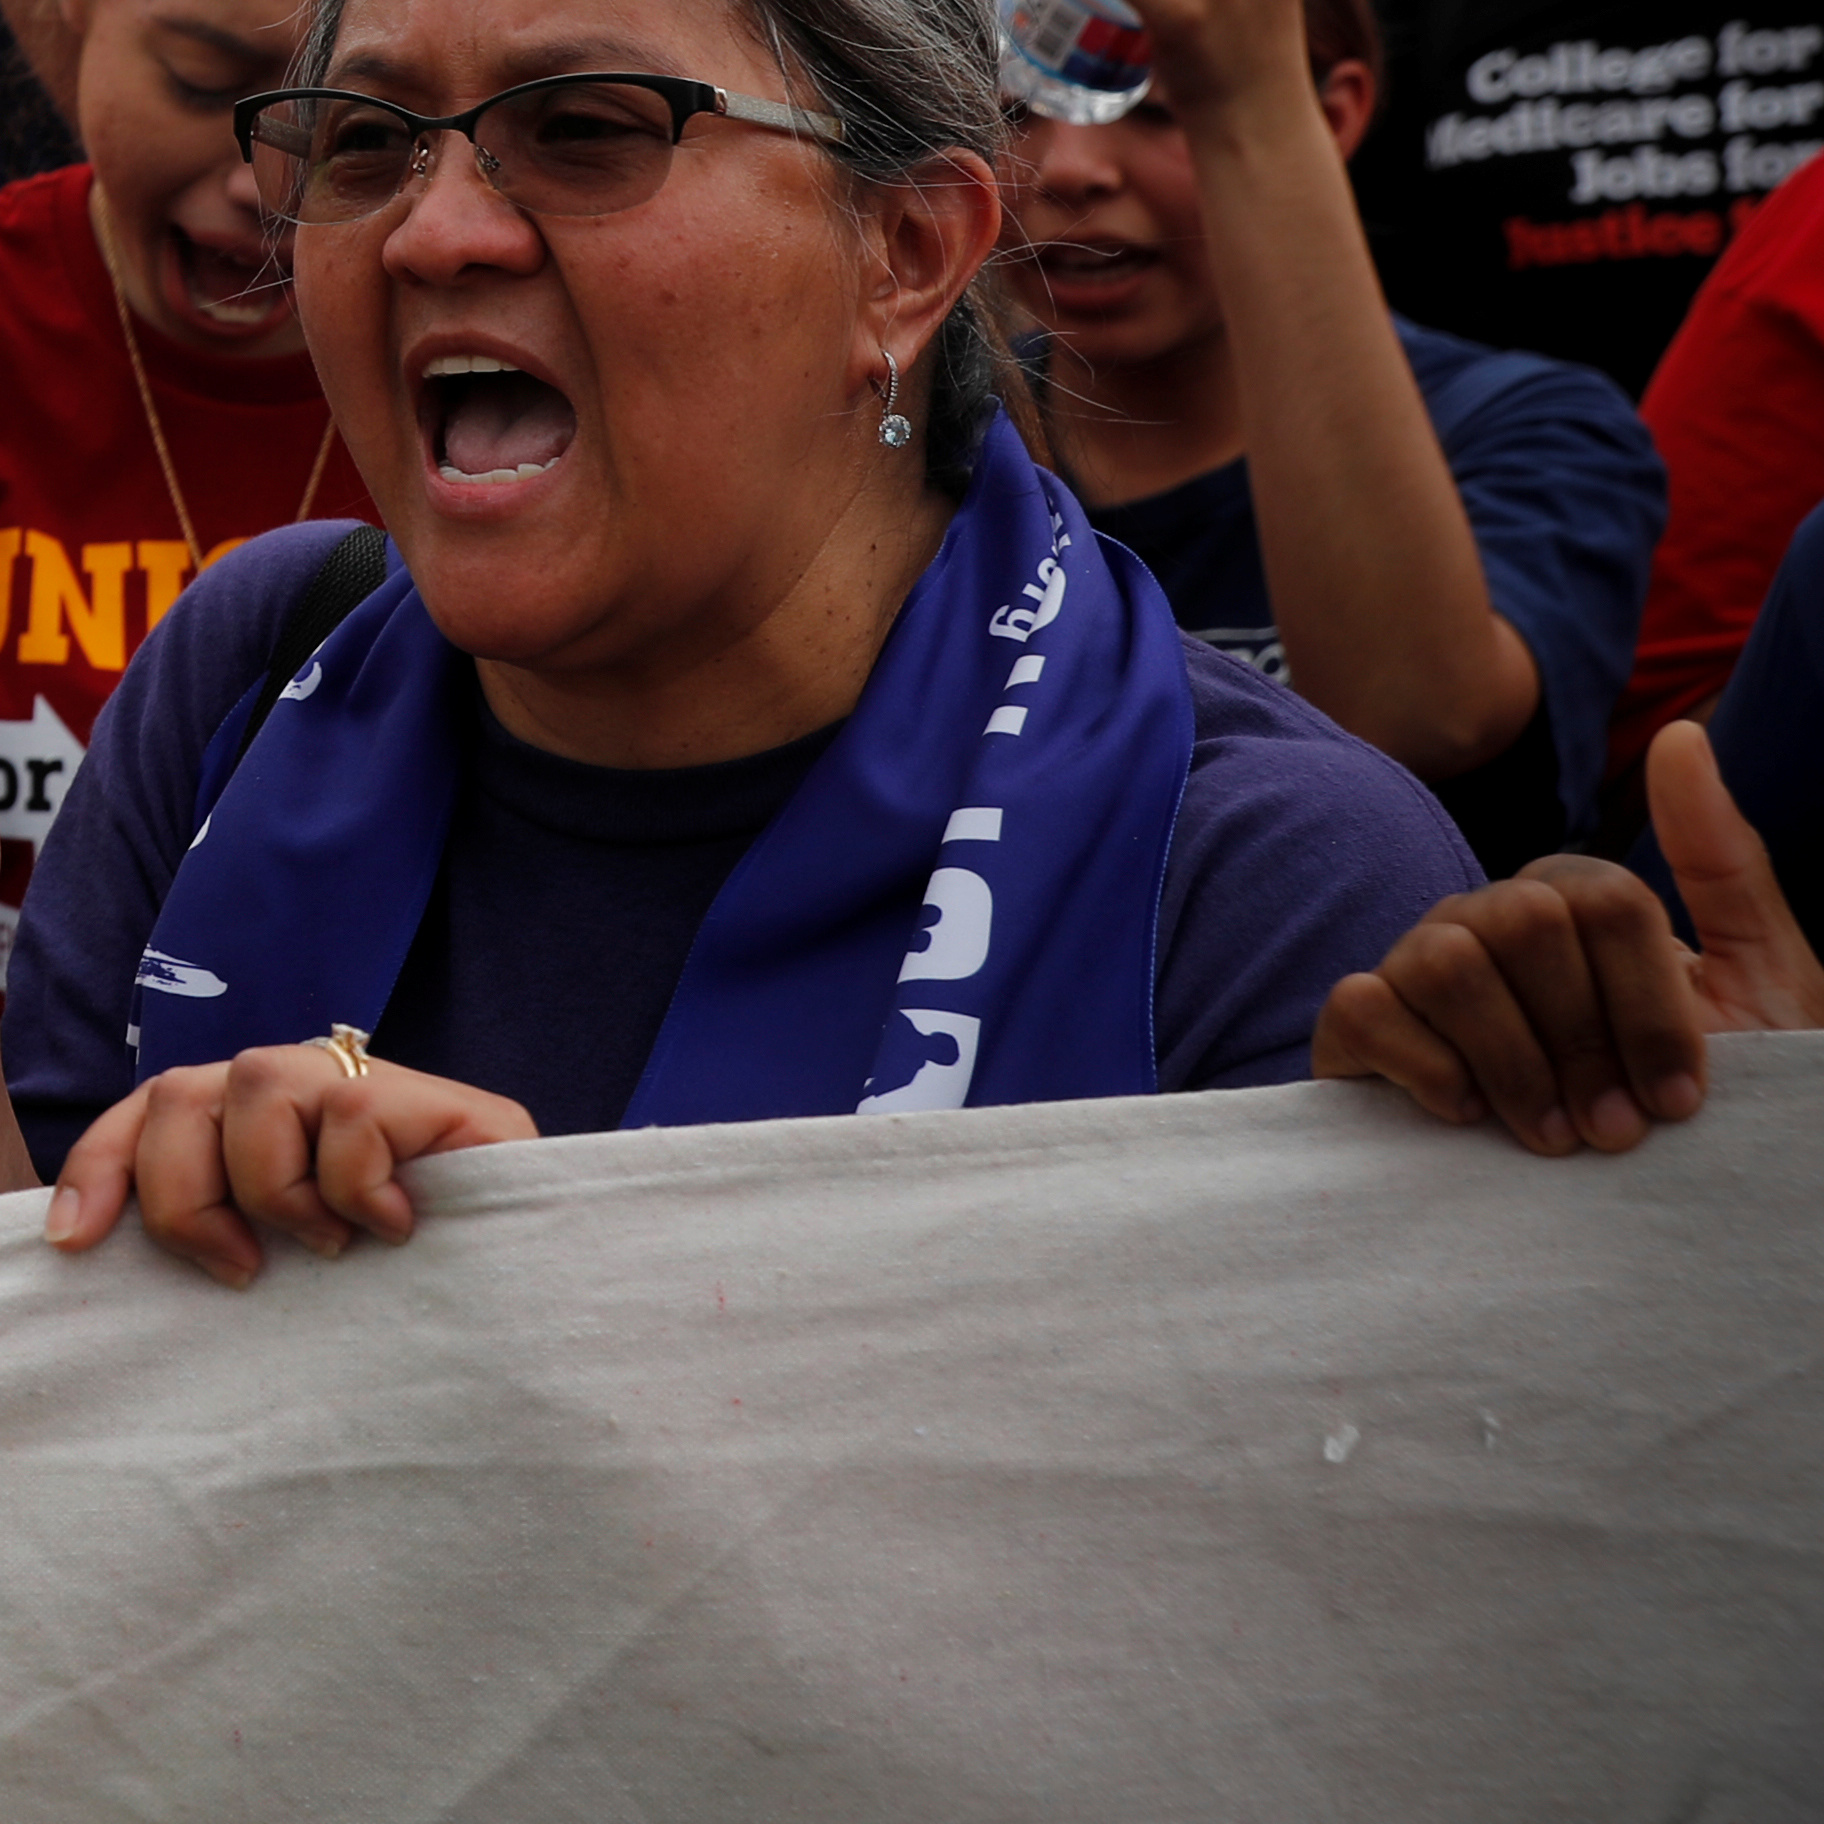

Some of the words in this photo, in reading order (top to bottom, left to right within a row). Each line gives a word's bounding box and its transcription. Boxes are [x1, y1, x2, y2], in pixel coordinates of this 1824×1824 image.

[1464, 34, 1715, 105] College
[1715, 19, 1824, 78] for
[1718, 78, 1824, 133] for
[1566, 143, 1722, 206] Jobs
